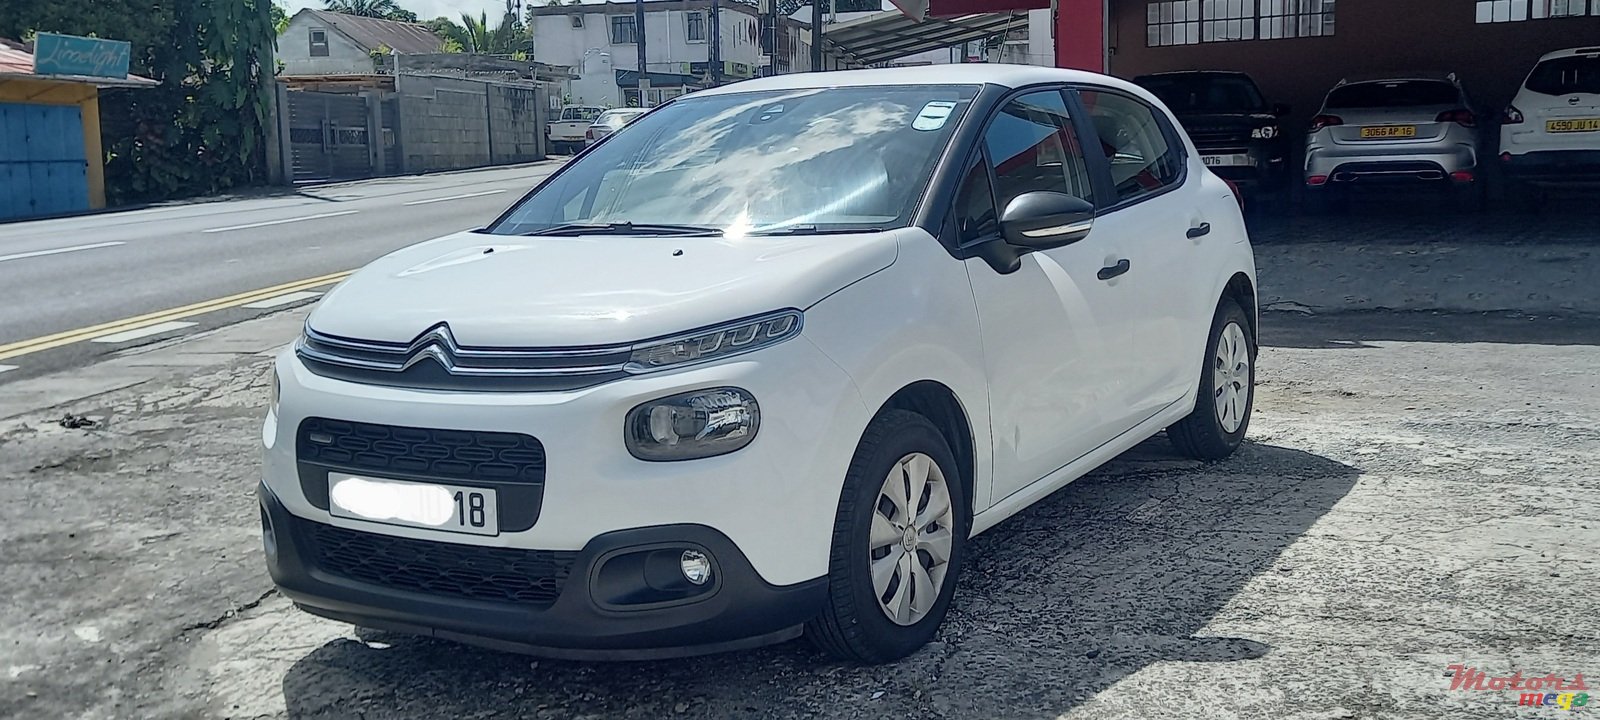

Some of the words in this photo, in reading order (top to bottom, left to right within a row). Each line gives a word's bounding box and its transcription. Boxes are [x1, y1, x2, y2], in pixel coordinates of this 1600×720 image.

[39, 39, 127, 75] Limelight
[1364, 128, 1387, 136] 3066
[1388, 127, 1399, 135] AP
[1402, 127, 1412, 135] 16
[1574, 121, 1586, 130] JU
[1589, 120, 1598, 129] 14
[453, 490, 485, 527] 18
